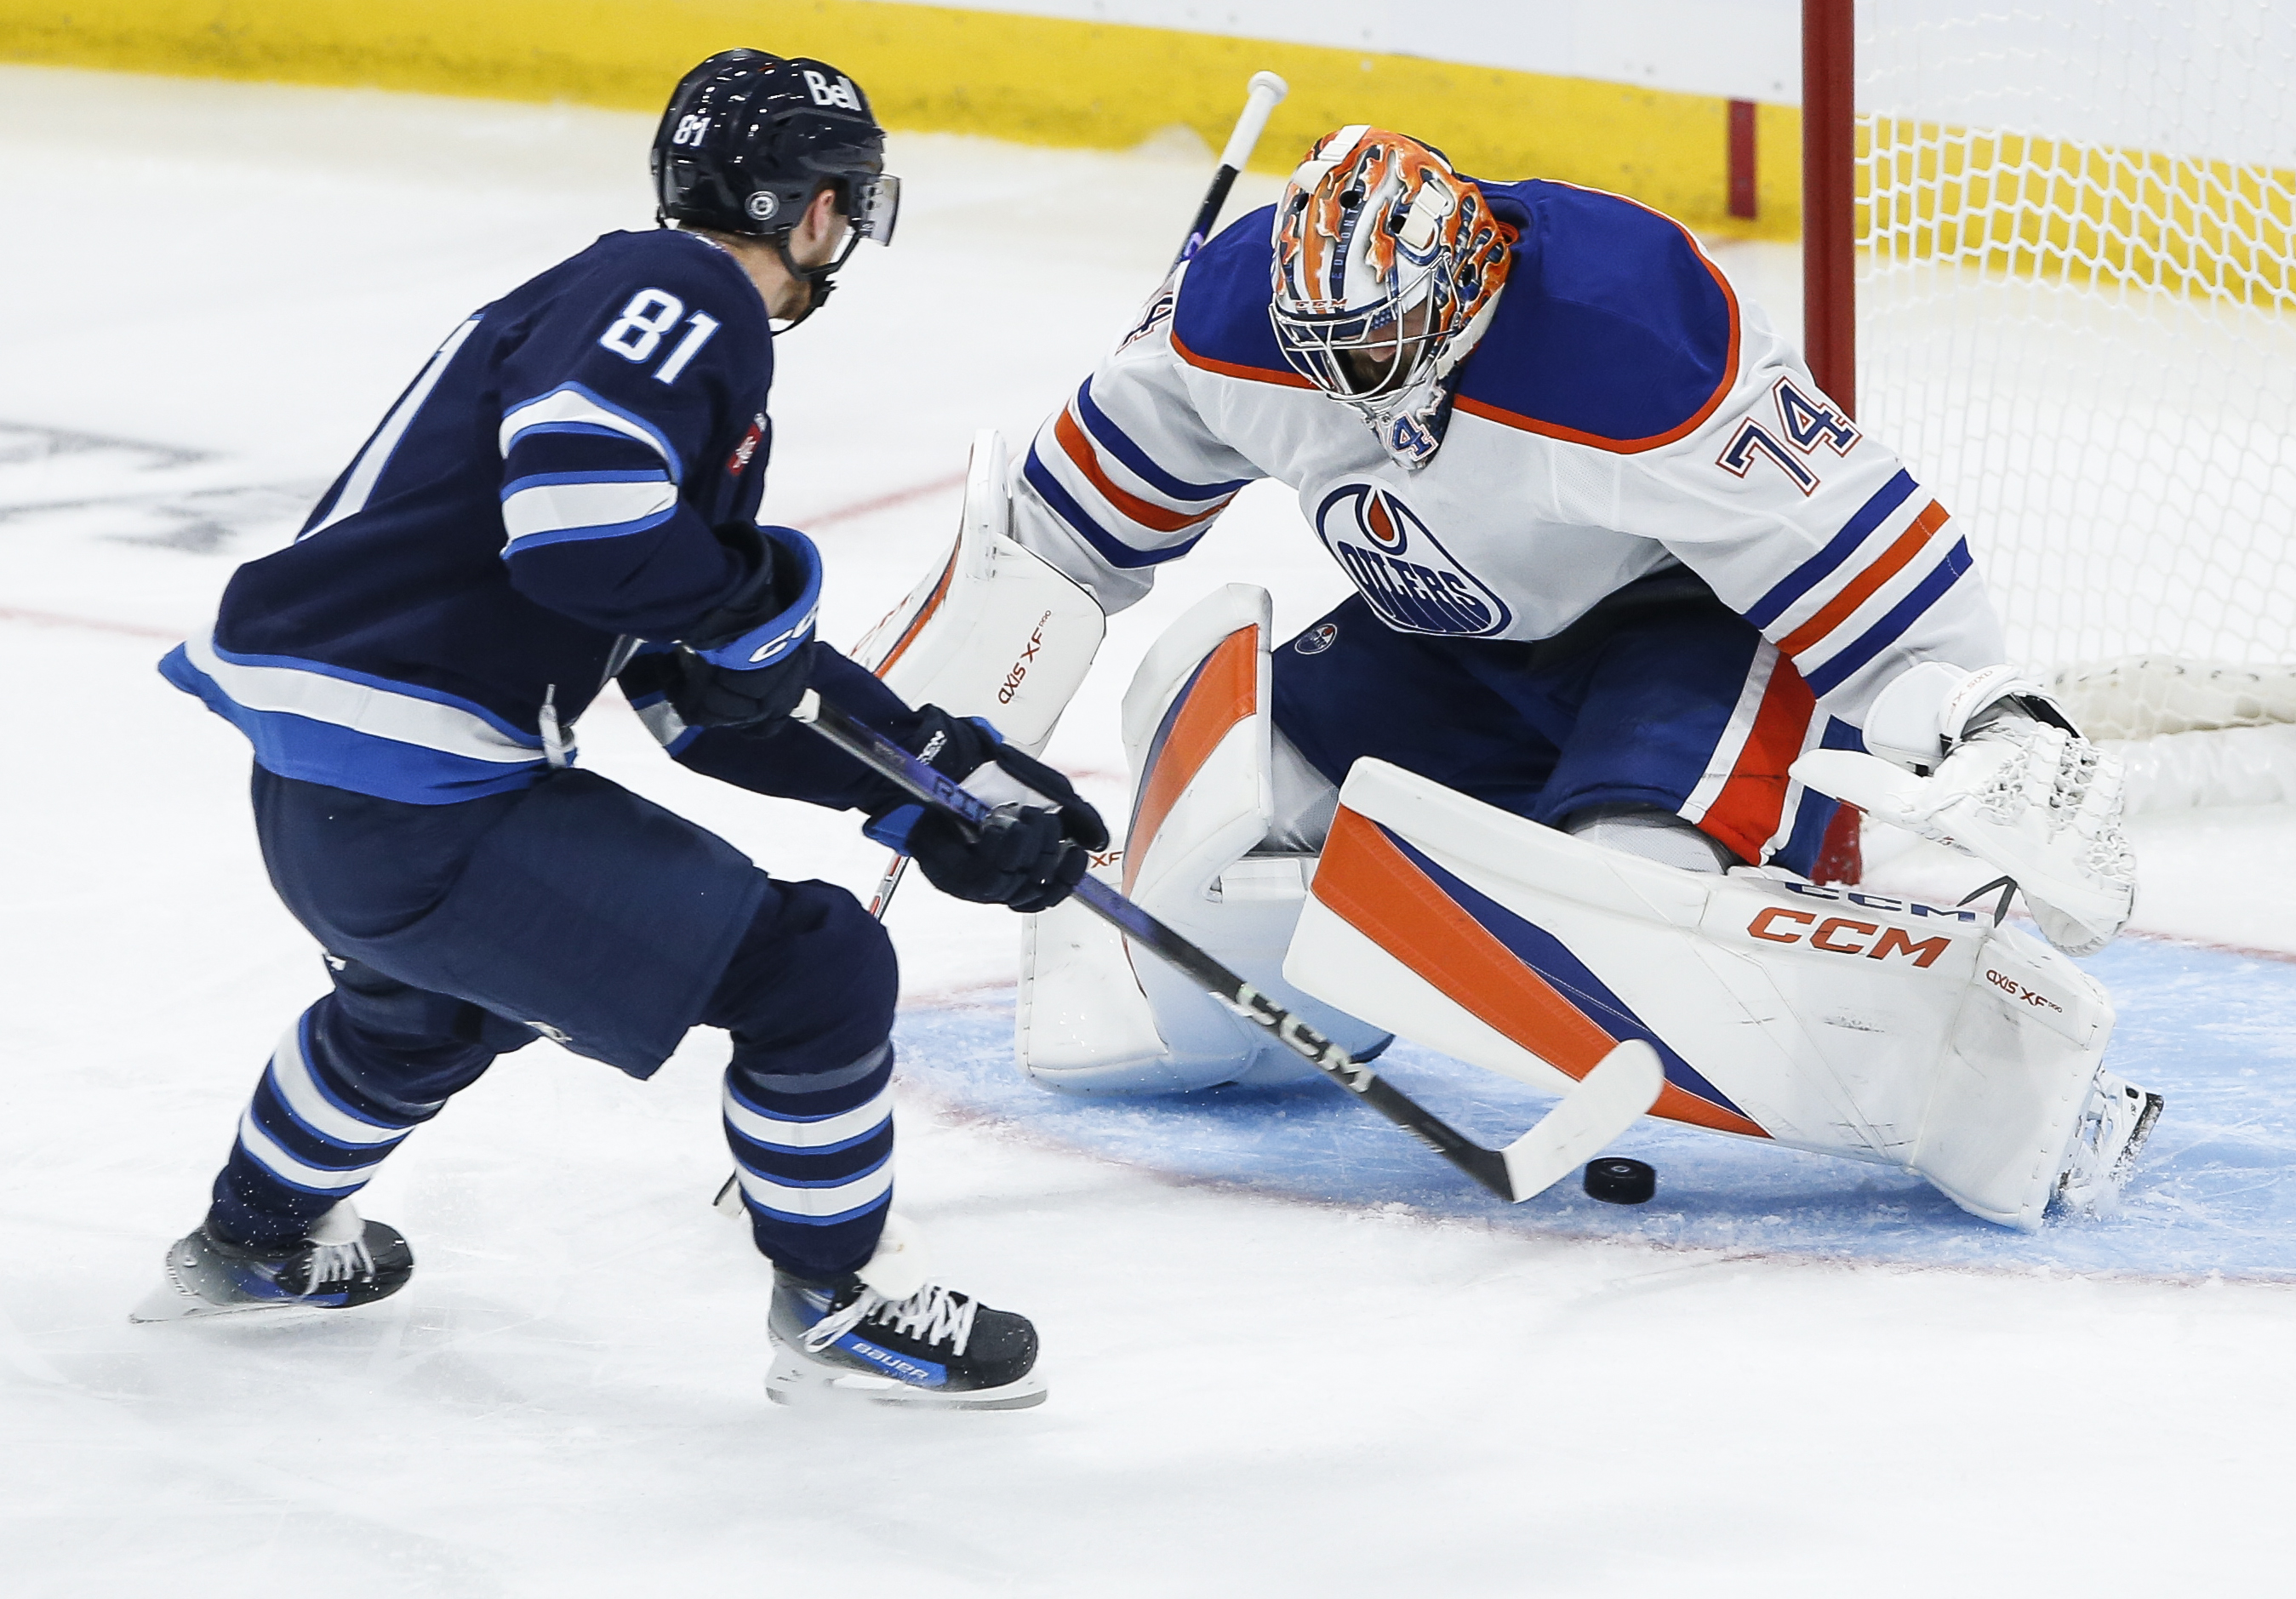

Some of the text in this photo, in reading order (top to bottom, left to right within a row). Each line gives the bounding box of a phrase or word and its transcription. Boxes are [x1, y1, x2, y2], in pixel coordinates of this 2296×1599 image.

[802, 70, 862, 111] Bell
[671, 114, 711, 147] 81
[1330, 184, 1365, 280] EDMONTN
[598, 286, 722, 385] 81
[1715, 374, 1864, 498] 74
[1337, 540, 1480, 608] OILERS
[1020, 626, 1043, 664] XF
[1746, 906, 1952, 969] CCM
[2019, 985, 2049, 1008] XF
[1236, 981, 1377, 1094] CCM
